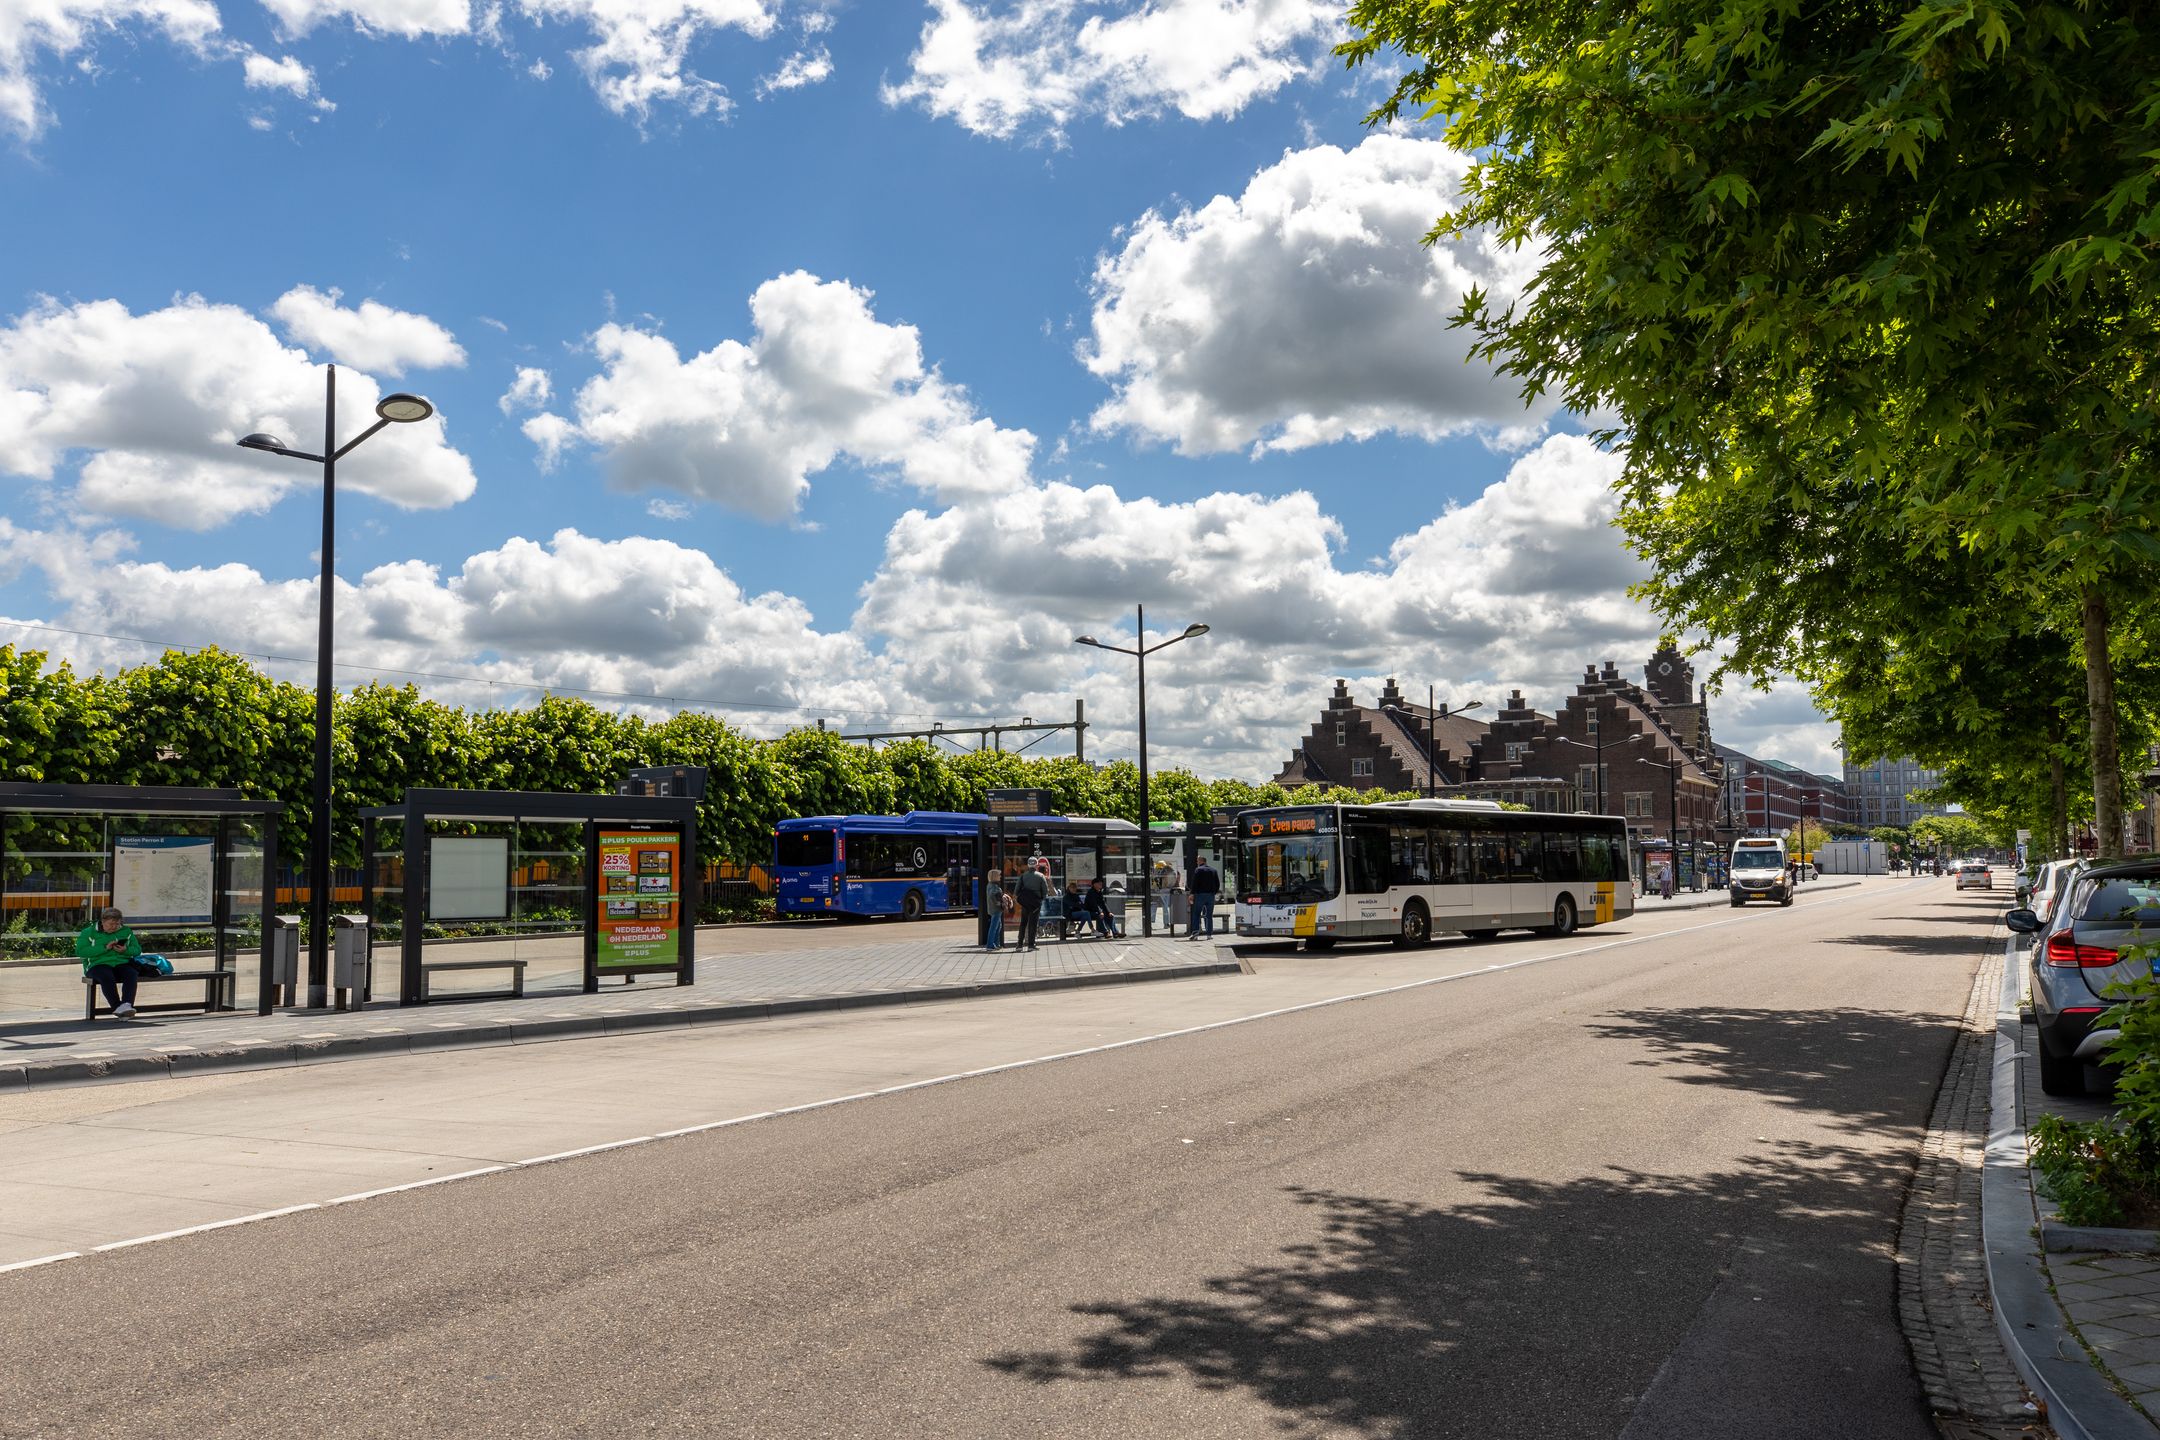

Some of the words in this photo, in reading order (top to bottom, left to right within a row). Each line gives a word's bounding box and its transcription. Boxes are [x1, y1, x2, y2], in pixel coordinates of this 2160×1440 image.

[1270, 818, 1290, 832] Even
[1292, 818, 1316, 832] pauze
[606, 854, 628, 864] 25%
[622, 934, 666, 942] NEDERLAND
